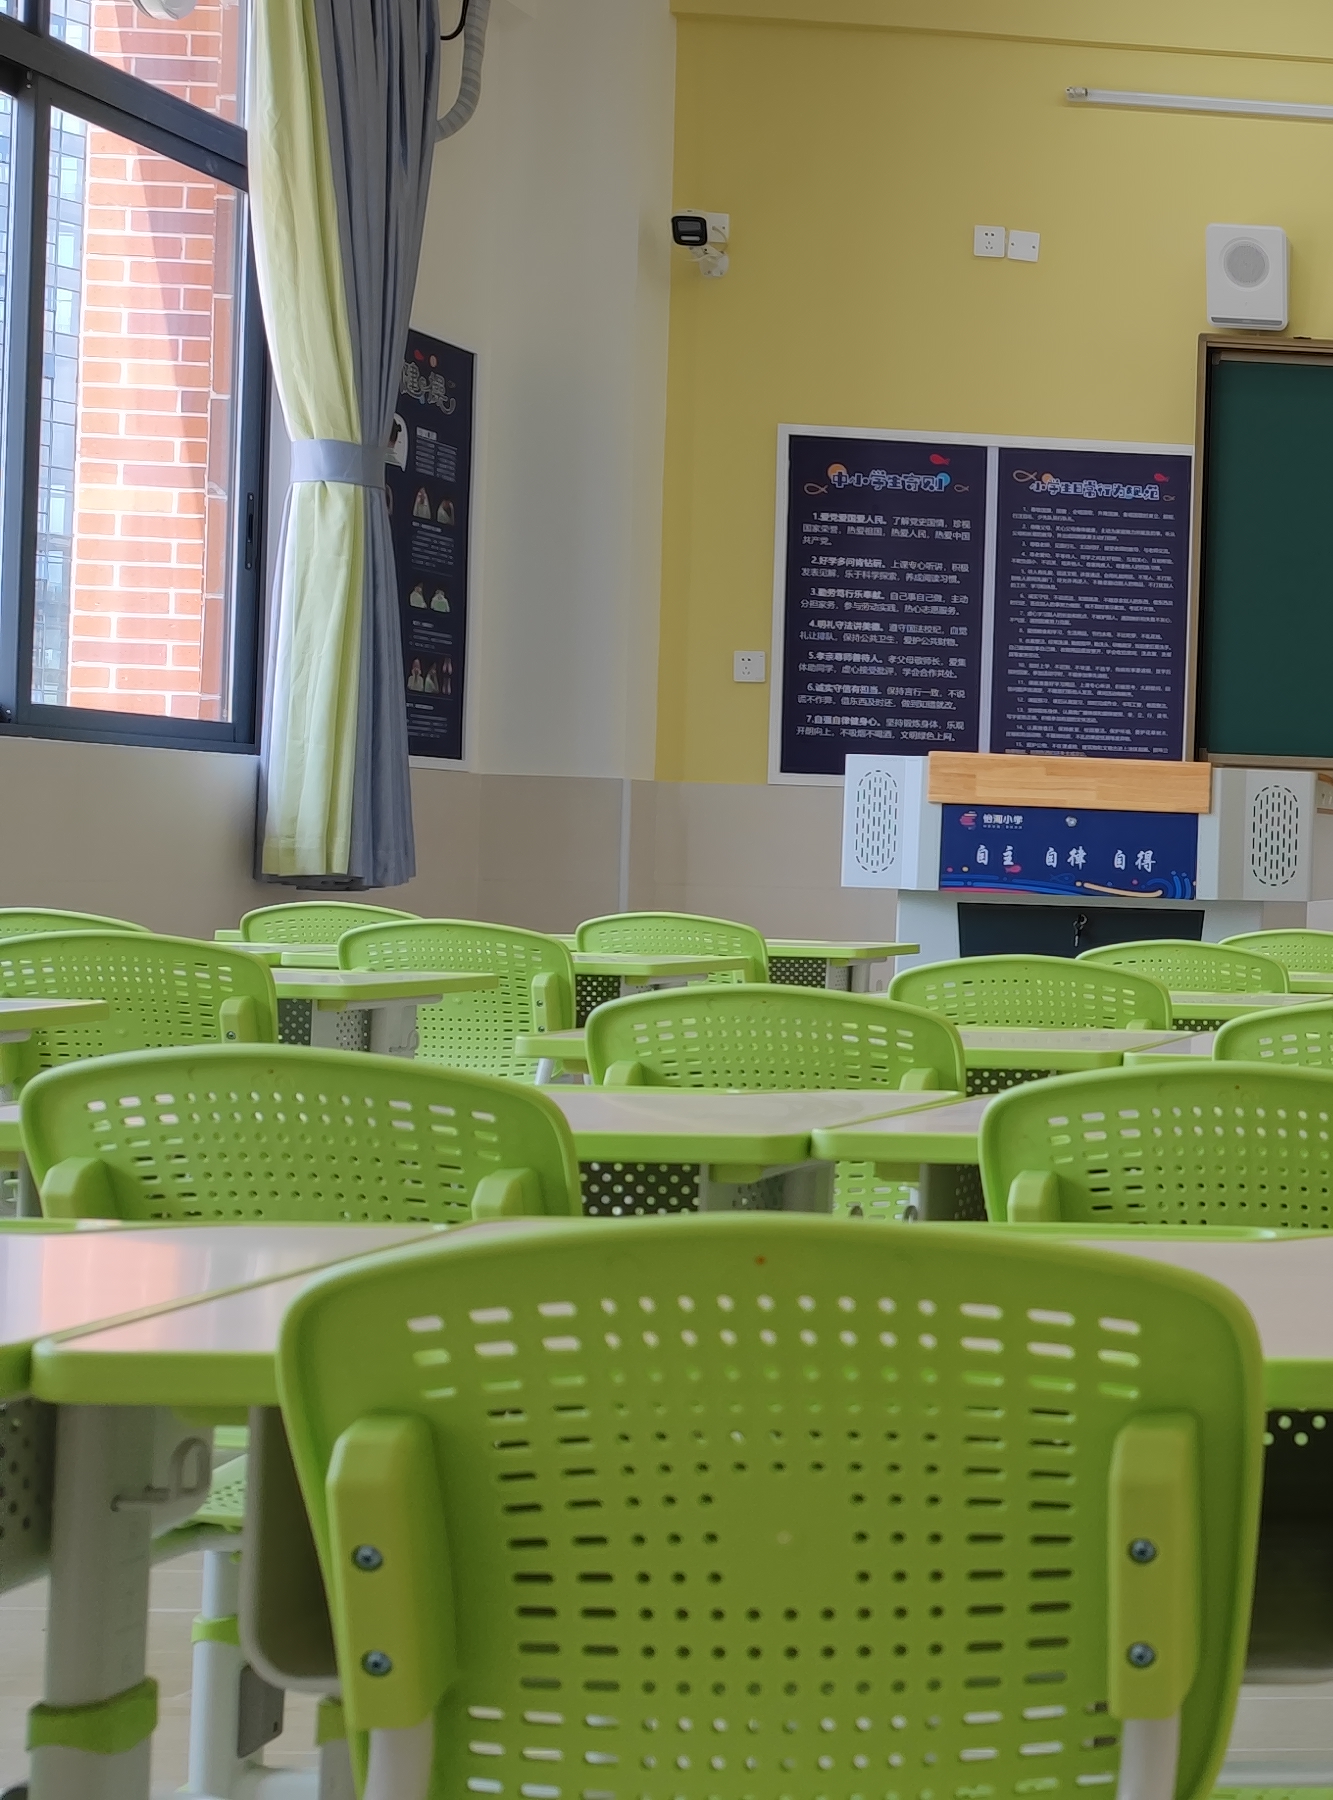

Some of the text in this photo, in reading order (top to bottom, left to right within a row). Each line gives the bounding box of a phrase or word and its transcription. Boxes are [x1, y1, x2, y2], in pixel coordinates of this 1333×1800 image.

[831, 469, 945, 492] 中小学生守则
[1029, 478, 1160, 501] 小学生日常行为规范
[976, 844, 1156, 873] 自主 自律 自得
